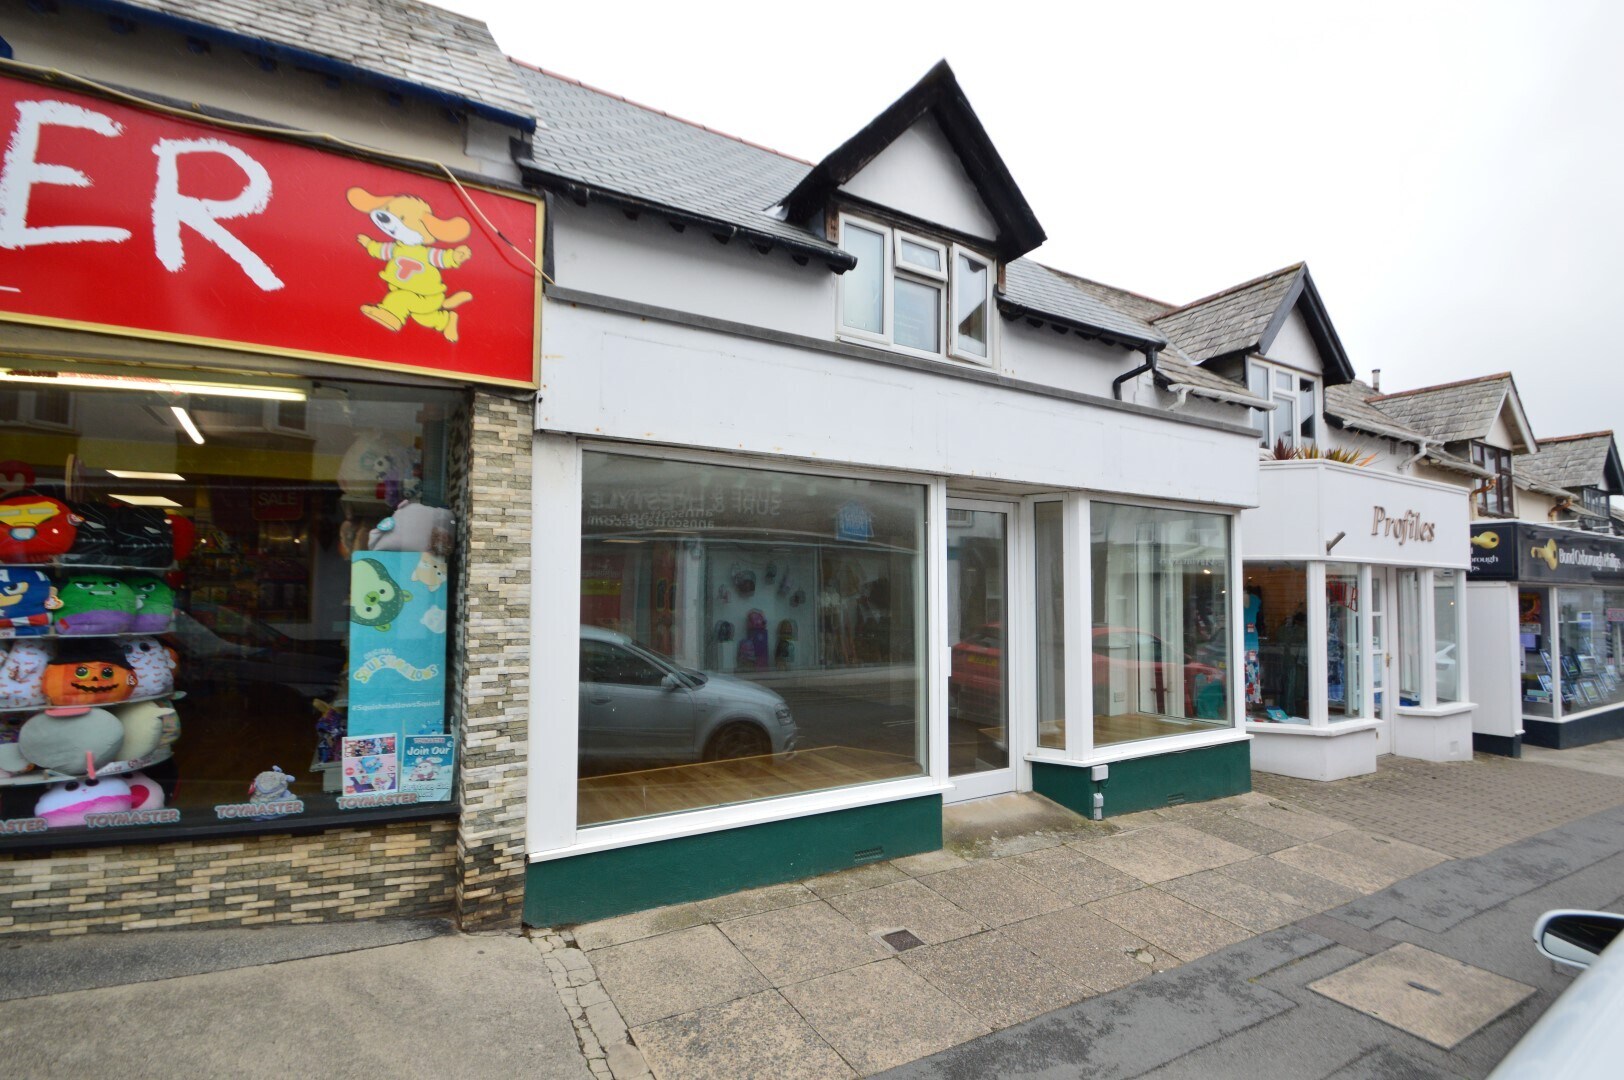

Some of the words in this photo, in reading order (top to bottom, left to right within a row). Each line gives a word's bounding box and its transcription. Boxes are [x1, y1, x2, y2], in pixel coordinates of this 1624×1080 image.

[1371, 505, 1435, 546] Profiles
[1558, 548, 1575, 565] Bond
[407, 746, 429, 756] Join
[432, 746, 451, 755] Our
[216, 801, 303, 818] TOYMASTER
[337, 793, 417, 809] TOYMASTER
[86, 810, 180, 827] TOYMASTER
